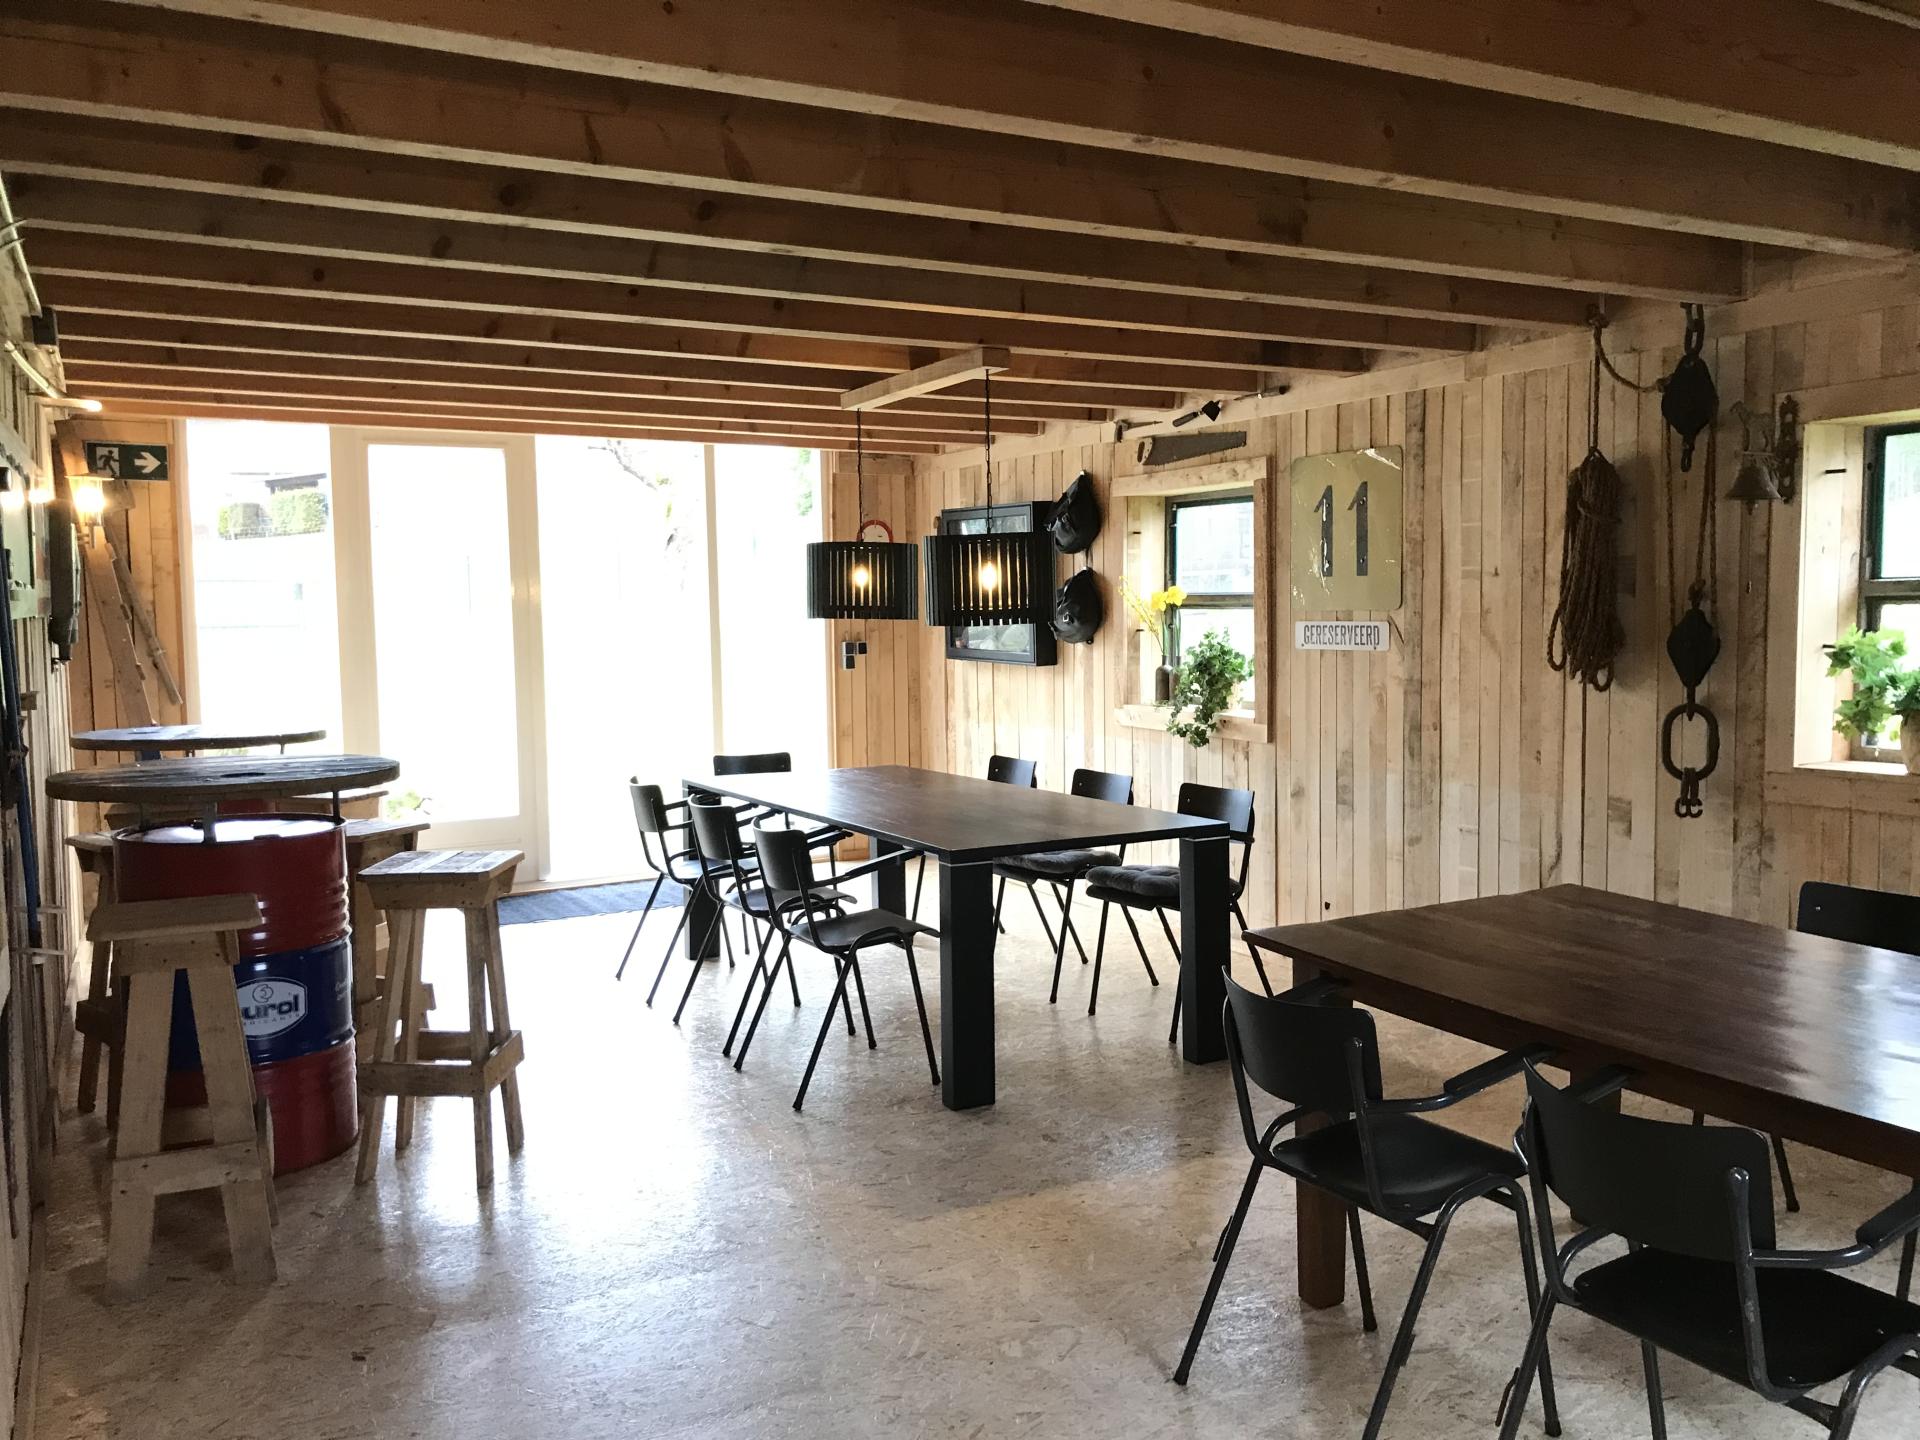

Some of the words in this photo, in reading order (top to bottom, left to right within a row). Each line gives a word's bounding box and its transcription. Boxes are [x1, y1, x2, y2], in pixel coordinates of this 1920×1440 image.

[1313, 481, 1368, 577] 11
[1303, 624, 1380, 646] GERESERVEERD
[241, 994, 299, 1019] urol
